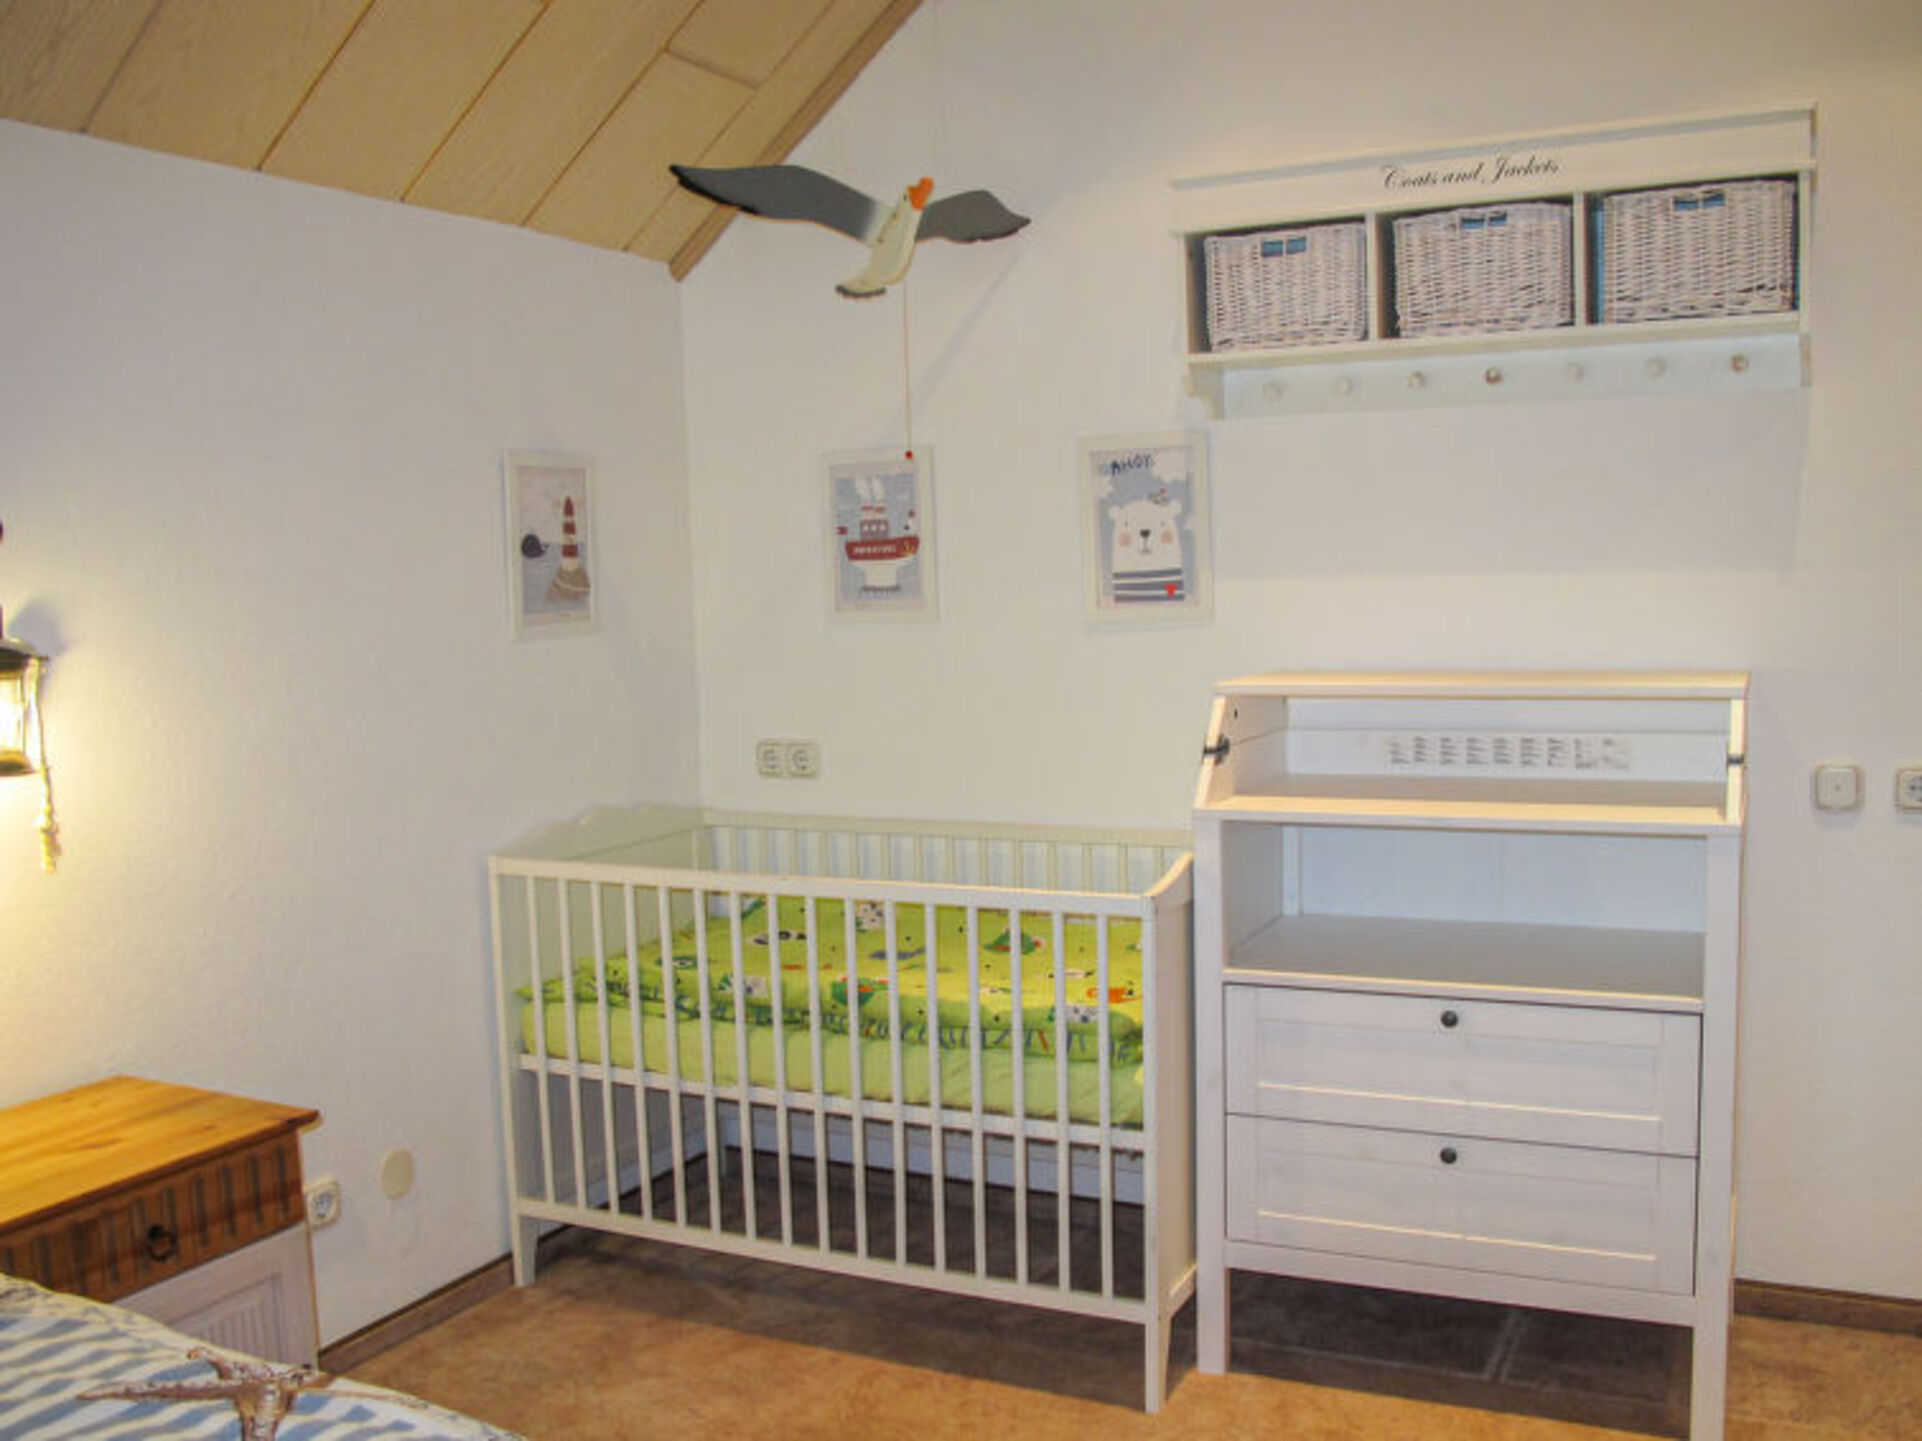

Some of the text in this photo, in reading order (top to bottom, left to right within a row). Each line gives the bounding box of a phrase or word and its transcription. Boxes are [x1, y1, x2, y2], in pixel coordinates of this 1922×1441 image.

[1382, 153, 1560, 188] Coats and Jackets
